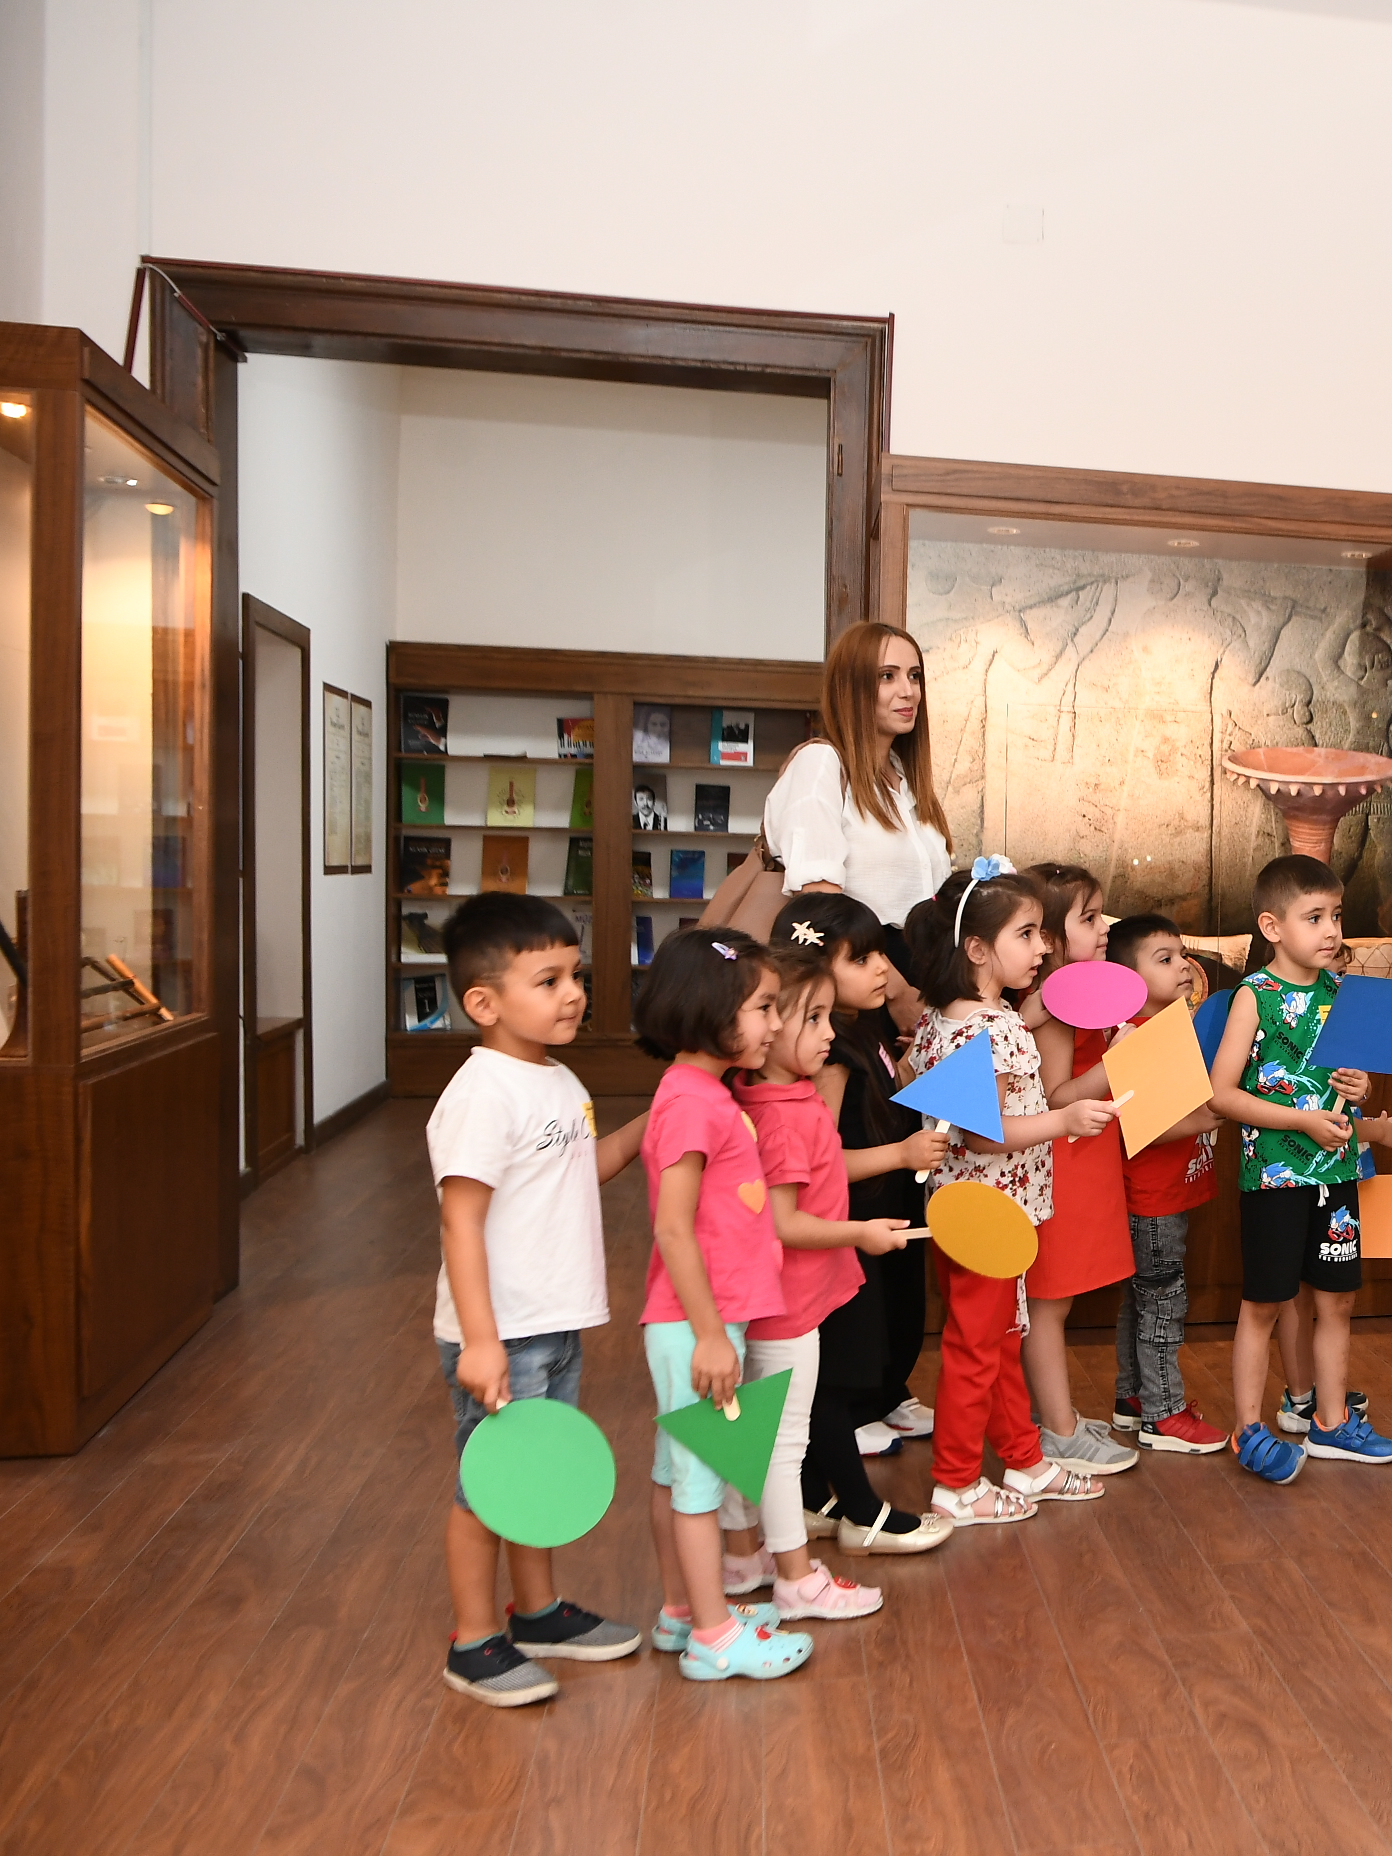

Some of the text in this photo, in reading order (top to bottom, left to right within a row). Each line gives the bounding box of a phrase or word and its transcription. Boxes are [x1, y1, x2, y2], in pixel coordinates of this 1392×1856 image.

[1277, 1031, 1303, 1060] SONIC
[1281, 1134, 1314, 1162] SONIC
[1320, 1239, 1357, 1256] SONIC
